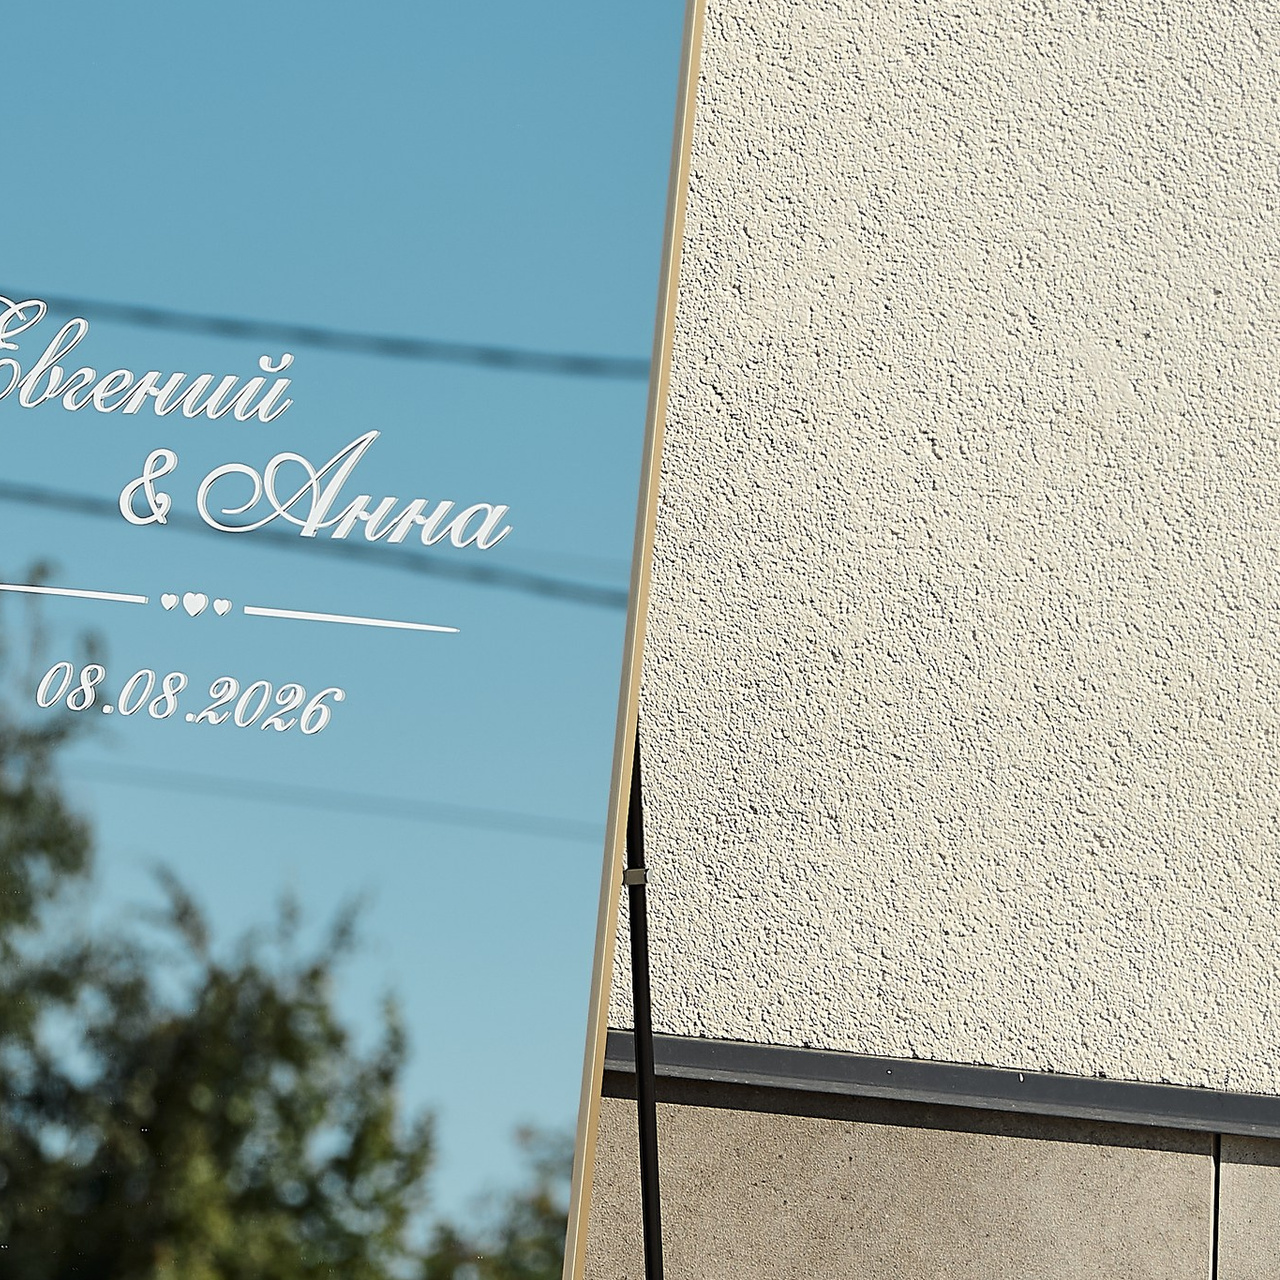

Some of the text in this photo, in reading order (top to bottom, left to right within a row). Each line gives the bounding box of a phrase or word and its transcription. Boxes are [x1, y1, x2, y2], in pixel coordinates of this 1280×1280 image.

[119, 429, 514, 551] & Анна
[35, 661, 347, 736] 08.08.2026
